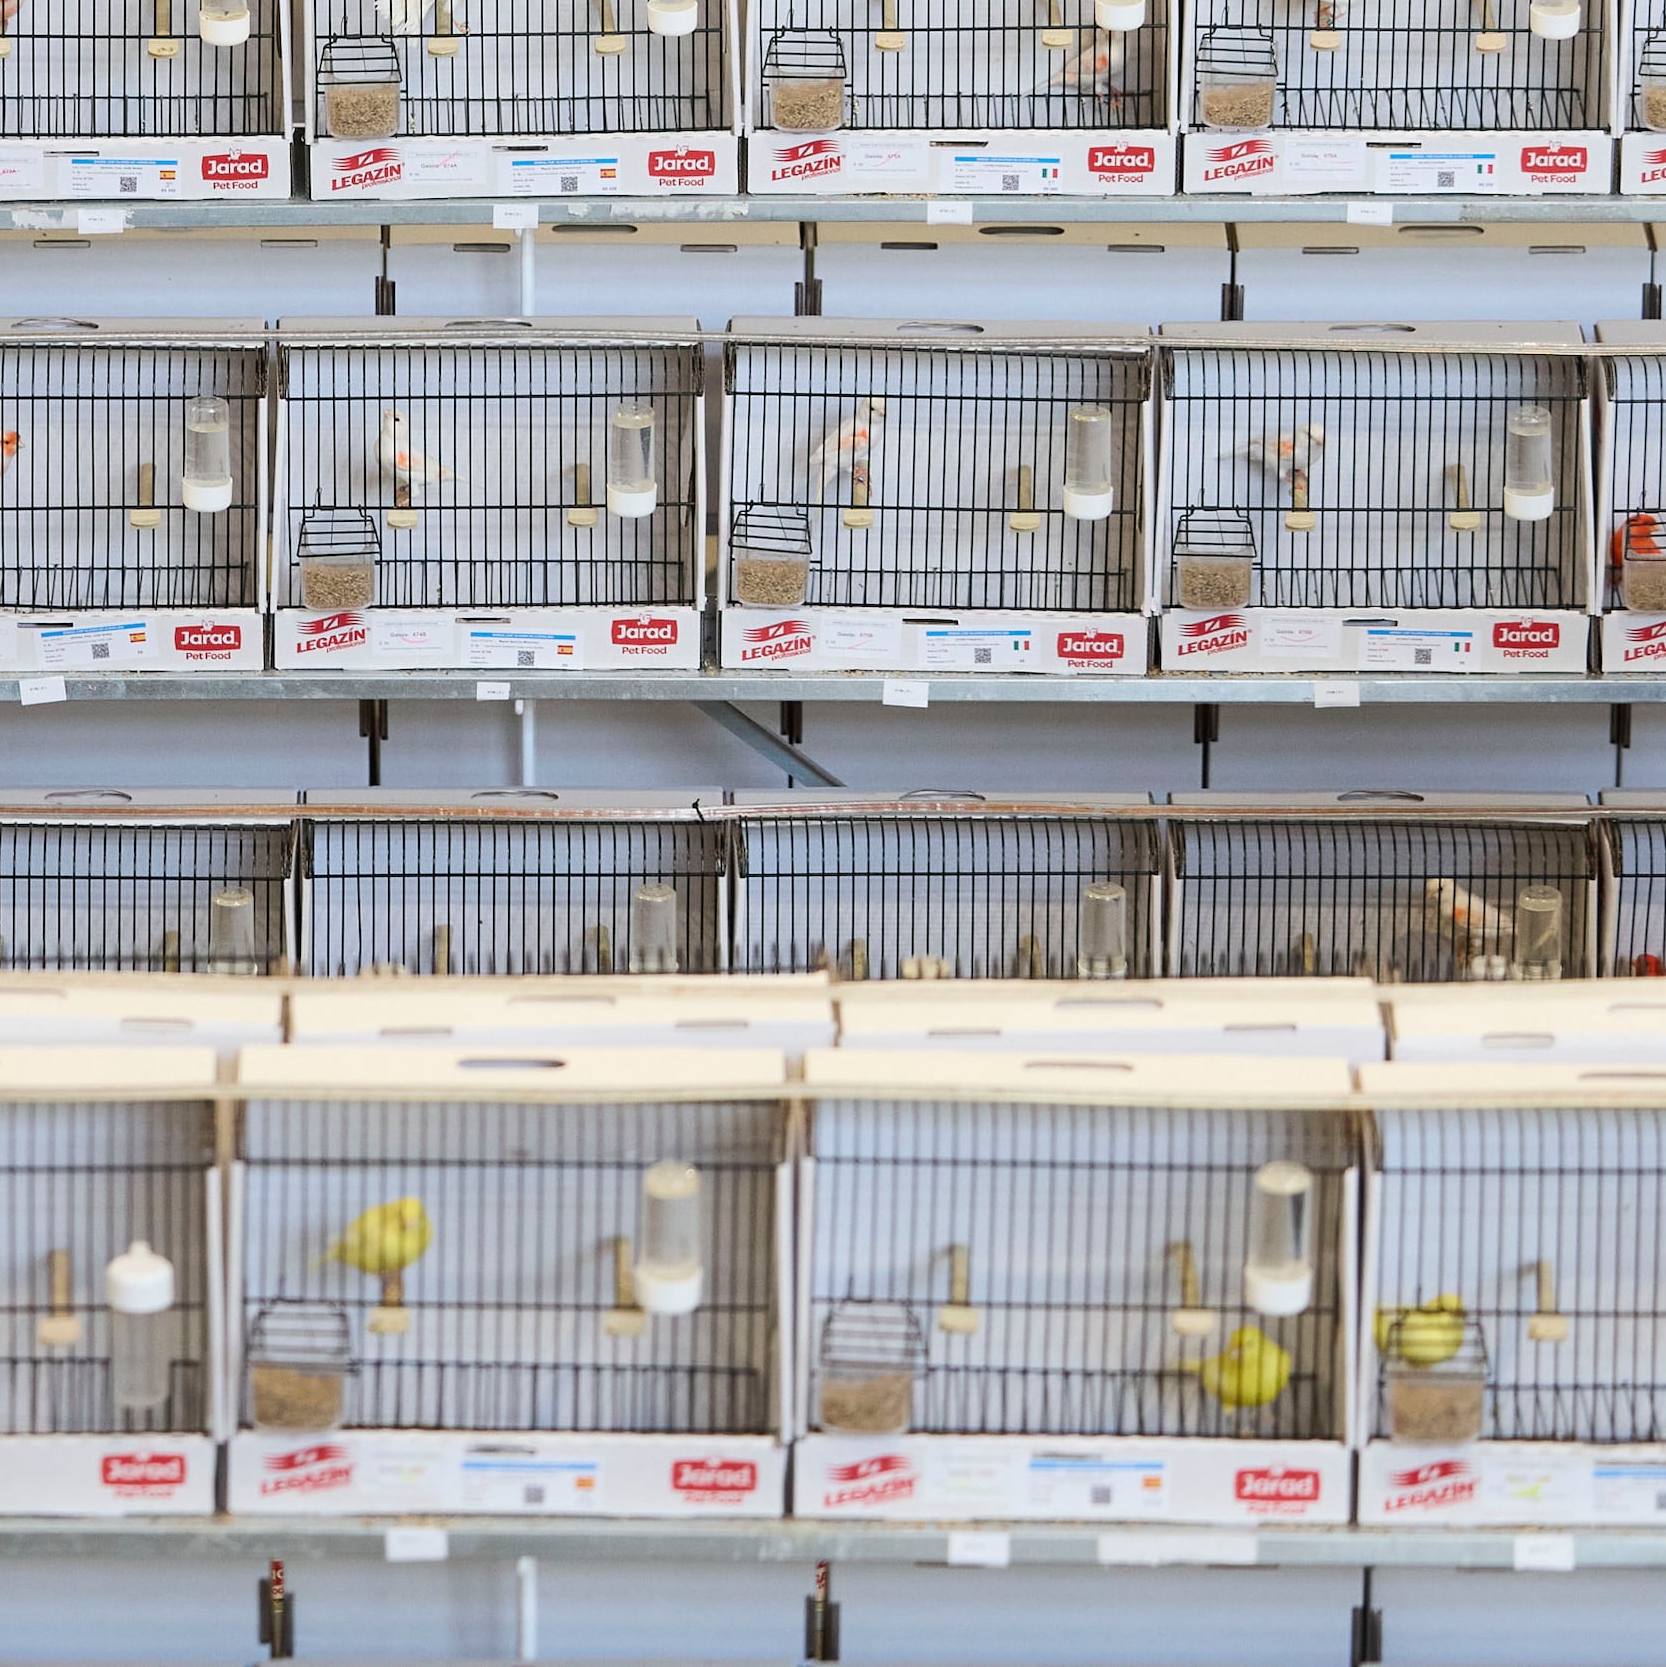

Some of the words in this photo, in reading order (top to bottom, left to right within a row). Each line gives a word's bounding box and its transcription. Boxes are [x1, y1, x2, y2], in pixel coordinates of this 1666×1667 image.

[207, 160, 263, 174] Jarad
[653, 156, 709, 170] Jarad
[1093, 152, 1149, 167] Jarad
[1527, 152, 1581, 167] Jarad
[772, 154, 843, 182] LEGAZÍN
[1205, 154, 1276, 182] LEGAZÍN
[332, 162, 403, 190] LEGAZÍN
[659, 178, 677, 186] Pet
[679, 178, 705, 186] Food
[1099, 175, 1117, 184] Pet
[1119, 175, 1145, 184] Food
[1533, 175, 1550, 184] Pet
[1552, 175, 1577, 184] Food
[213, 182, 231, 190] Pet
[233, 182, 259, 190] Food
[181, 630, 235, 645] Jarad
[617, 624, 671, 639] Jarad
[1499, 628, 1553, 642] Jarad
[297, 626, 368, 654] LEGAZÍN
[1063, 638, 1117, 653] Jarad
[1178, 629, 1249, 656] LEGAZÍN
[623, 647, 640, 656] Pet
[642, 647, 667, 656] Food
[742, 634, 813, 662] LEGAZÍN
[1505, 650, 1522, 658] Pet
[1524, 650, 1549, 658] Food
[187, 653, 204, 662] Pet
[206, 653, 231, 662] Food
[1069, 661, 1086, 670] Pet
[1088, 661, 1113, 670] Food
[1243, 1475, 1313, 1495] Jarad
